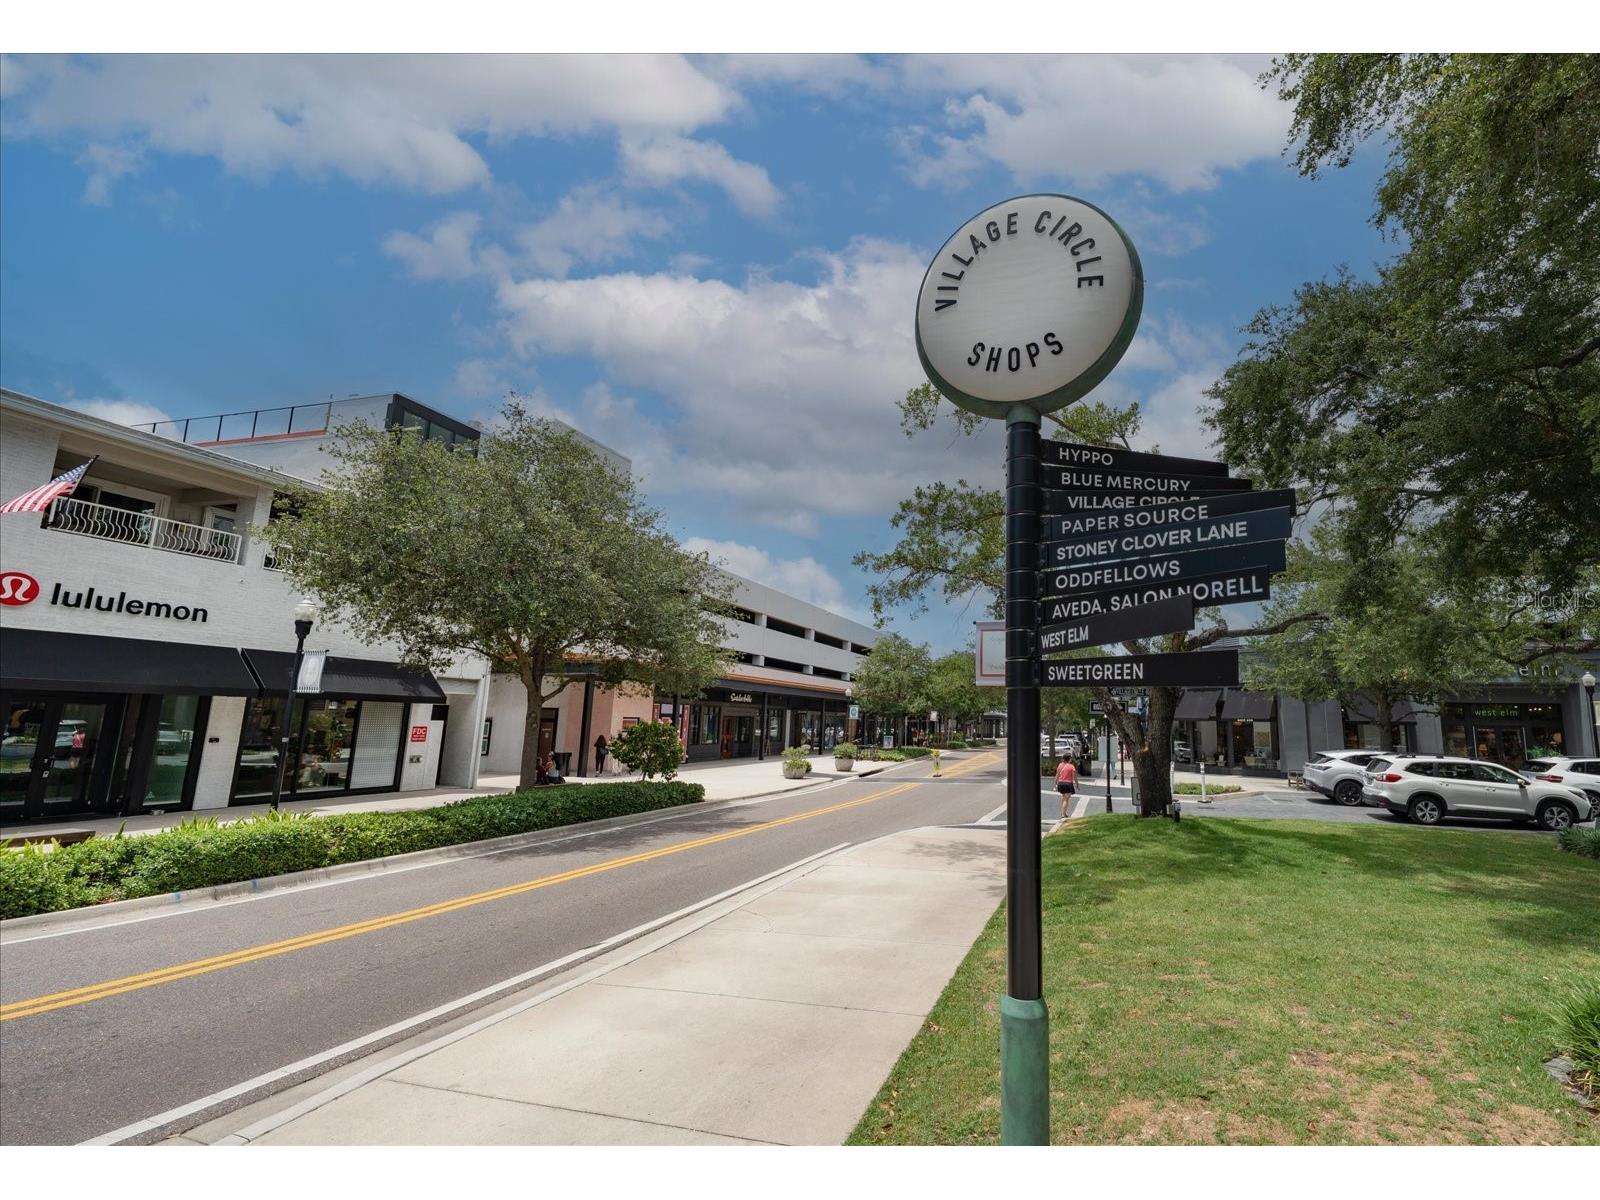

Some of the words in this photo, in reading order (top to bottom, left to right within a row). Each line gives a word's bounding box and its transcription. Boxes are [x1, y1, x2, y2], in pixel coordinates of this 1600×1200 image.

[934, 212, 1019, 312] VILLAGE
[1034, 210, 1104, 289] CIRCLE
[967, 332, 1064, 373] SHOPS
[1059, 447, 1113, 466] HYPPO
[1061, 472, 1103, 488] BLUE
[1106, 475, 1191, 491] MERCURY
[1068, 496, 1135, 509] VILLAGE
[1061, 514, 1119, 534] PAPER
[1124, 505, 1209, 528] SOURCE
[1056, 539, 1118, 560] STONEY
[1121, 529, 1192, 552] CLOVER
[1197, 521, 1248, 542] LANE
[1055, 560, 1181, 590] ODDFELLOWS
[51, 583, 208, 622] lululemon
[1052, 598, 1108, 620] AVEDA,
[1177, 575, 1264, 600] NORELL
[1041, 629, 1066, 649] WEST
[1068, 625, 1089, 643] ELM
[1048, 662, 1144, 681] SWEETGREEN
[1474, 709, 1497, 717] west
[1500, 709, 1519, 717] elm
